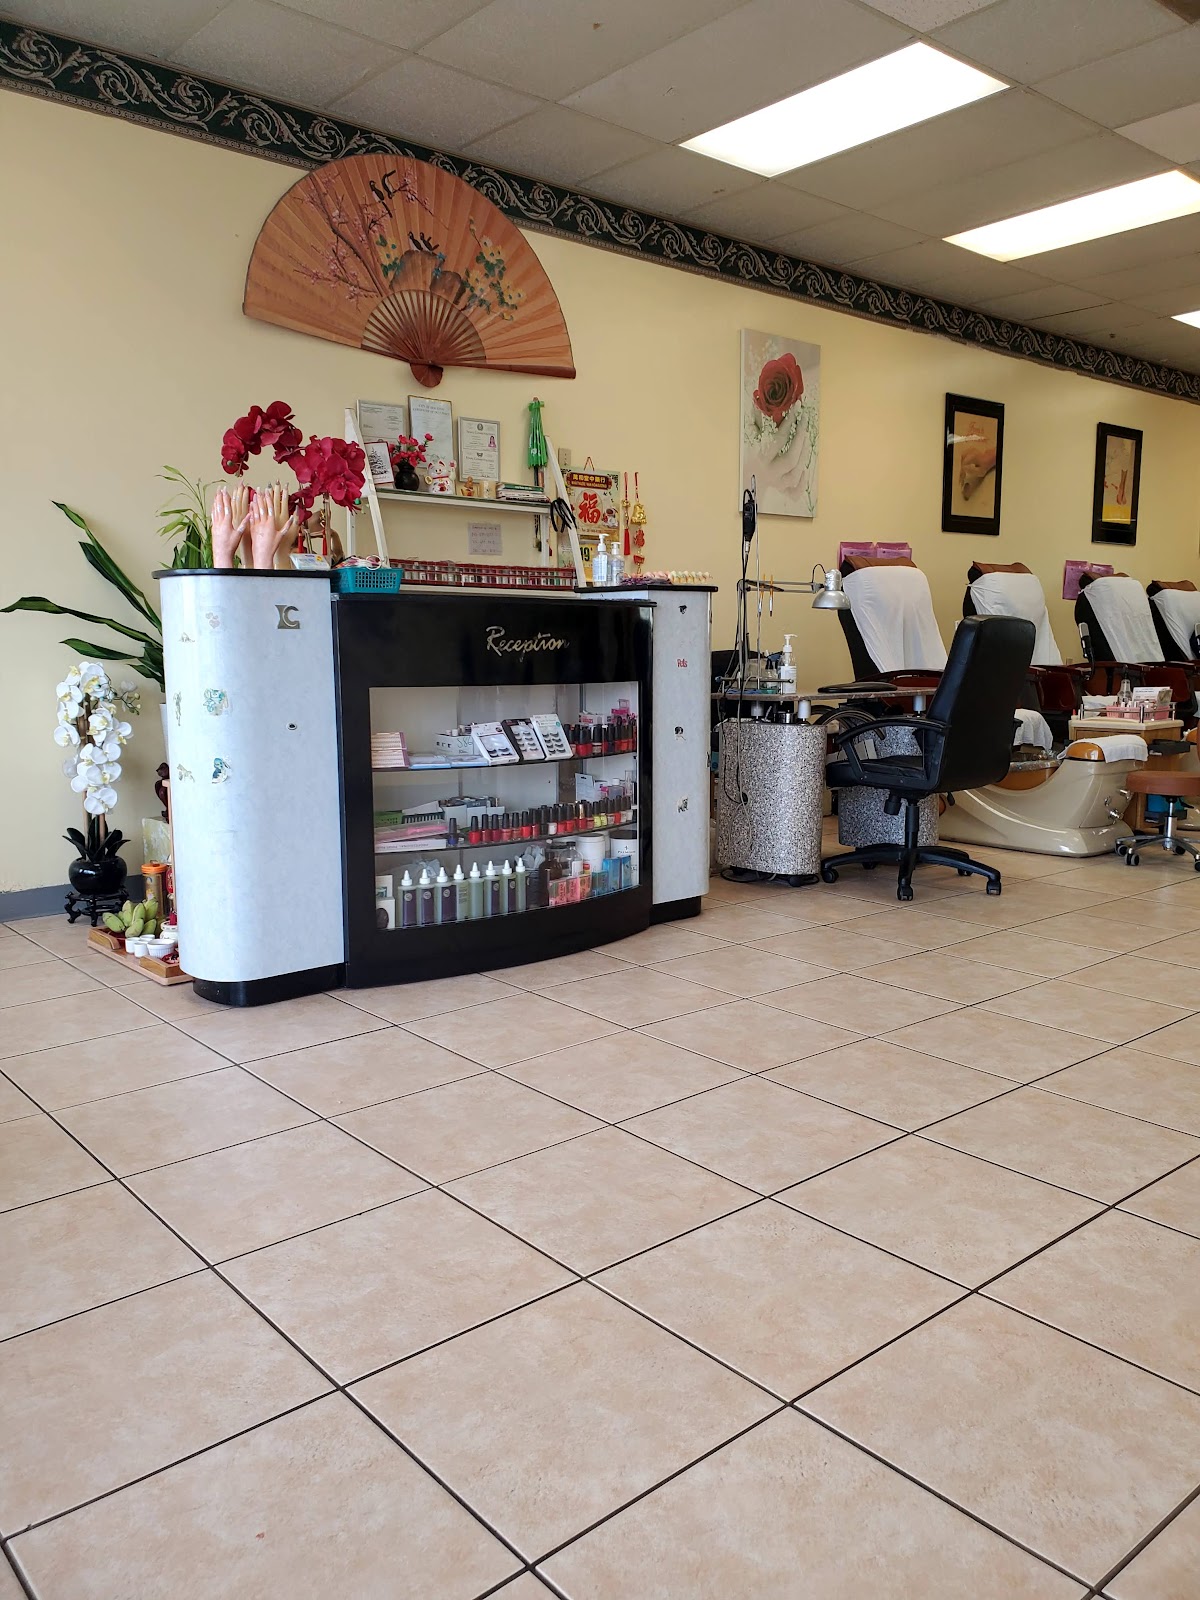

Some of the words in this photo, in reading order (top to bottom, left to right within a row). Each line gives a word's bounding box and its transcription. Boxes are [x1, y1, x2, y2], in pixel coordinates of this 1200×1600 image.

[578, 492, 601, 523] 福
[580, 547, 590, 561] 19
[485, 625, 570, 663] Reception
